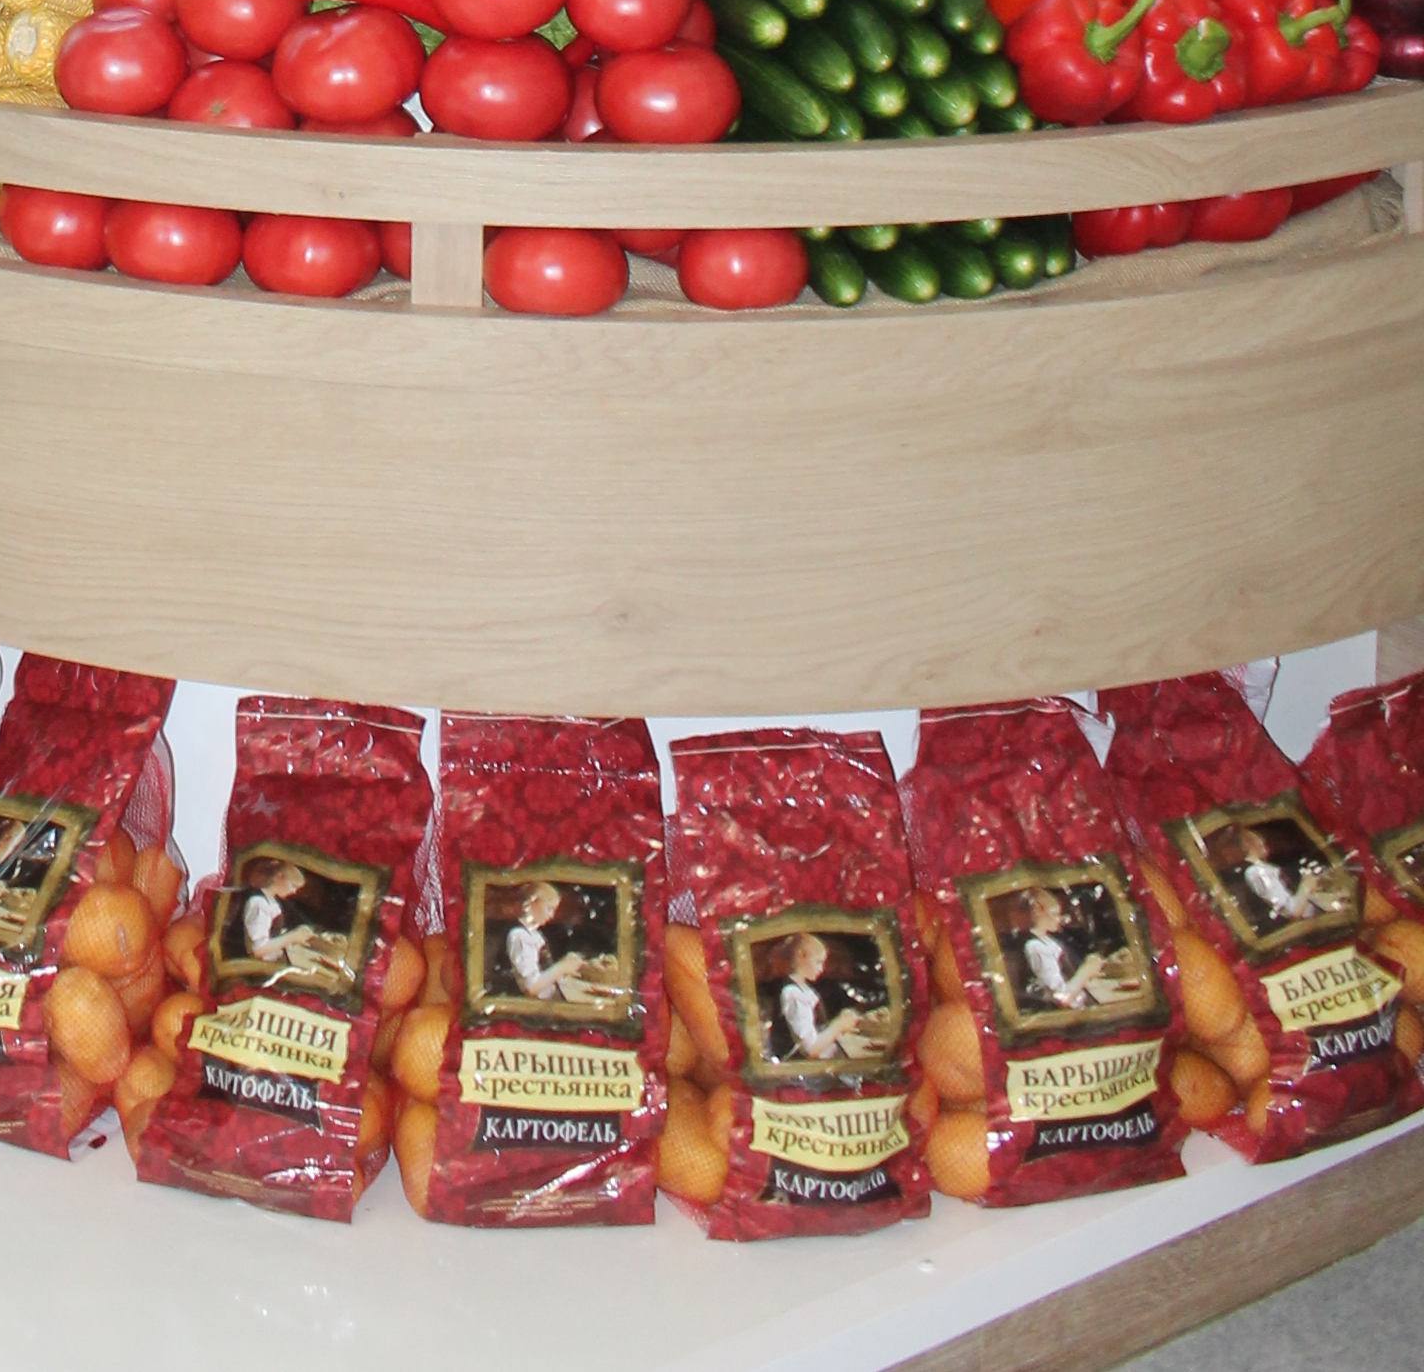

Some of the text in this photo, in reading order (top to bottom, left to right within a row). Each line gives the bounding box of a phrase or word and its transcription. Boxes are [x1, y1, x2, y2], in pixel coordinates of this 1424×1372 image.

[199, 1025, 333, 1069] крестьянка
[474, 1049, 631, 1078] БАРЫШНЯ
[205, 1064, 313, 1111] КАРТОФЕЛЬ
[473, 1075, 633, 1100] крестьянка
[484, 1116, 617, 1144] КАРТОФЕЛЬ
[766, 1125, 904, 1157] крестьянка
[1038, 1111, 1156, 1146] КАРТОФЕЛЬ
